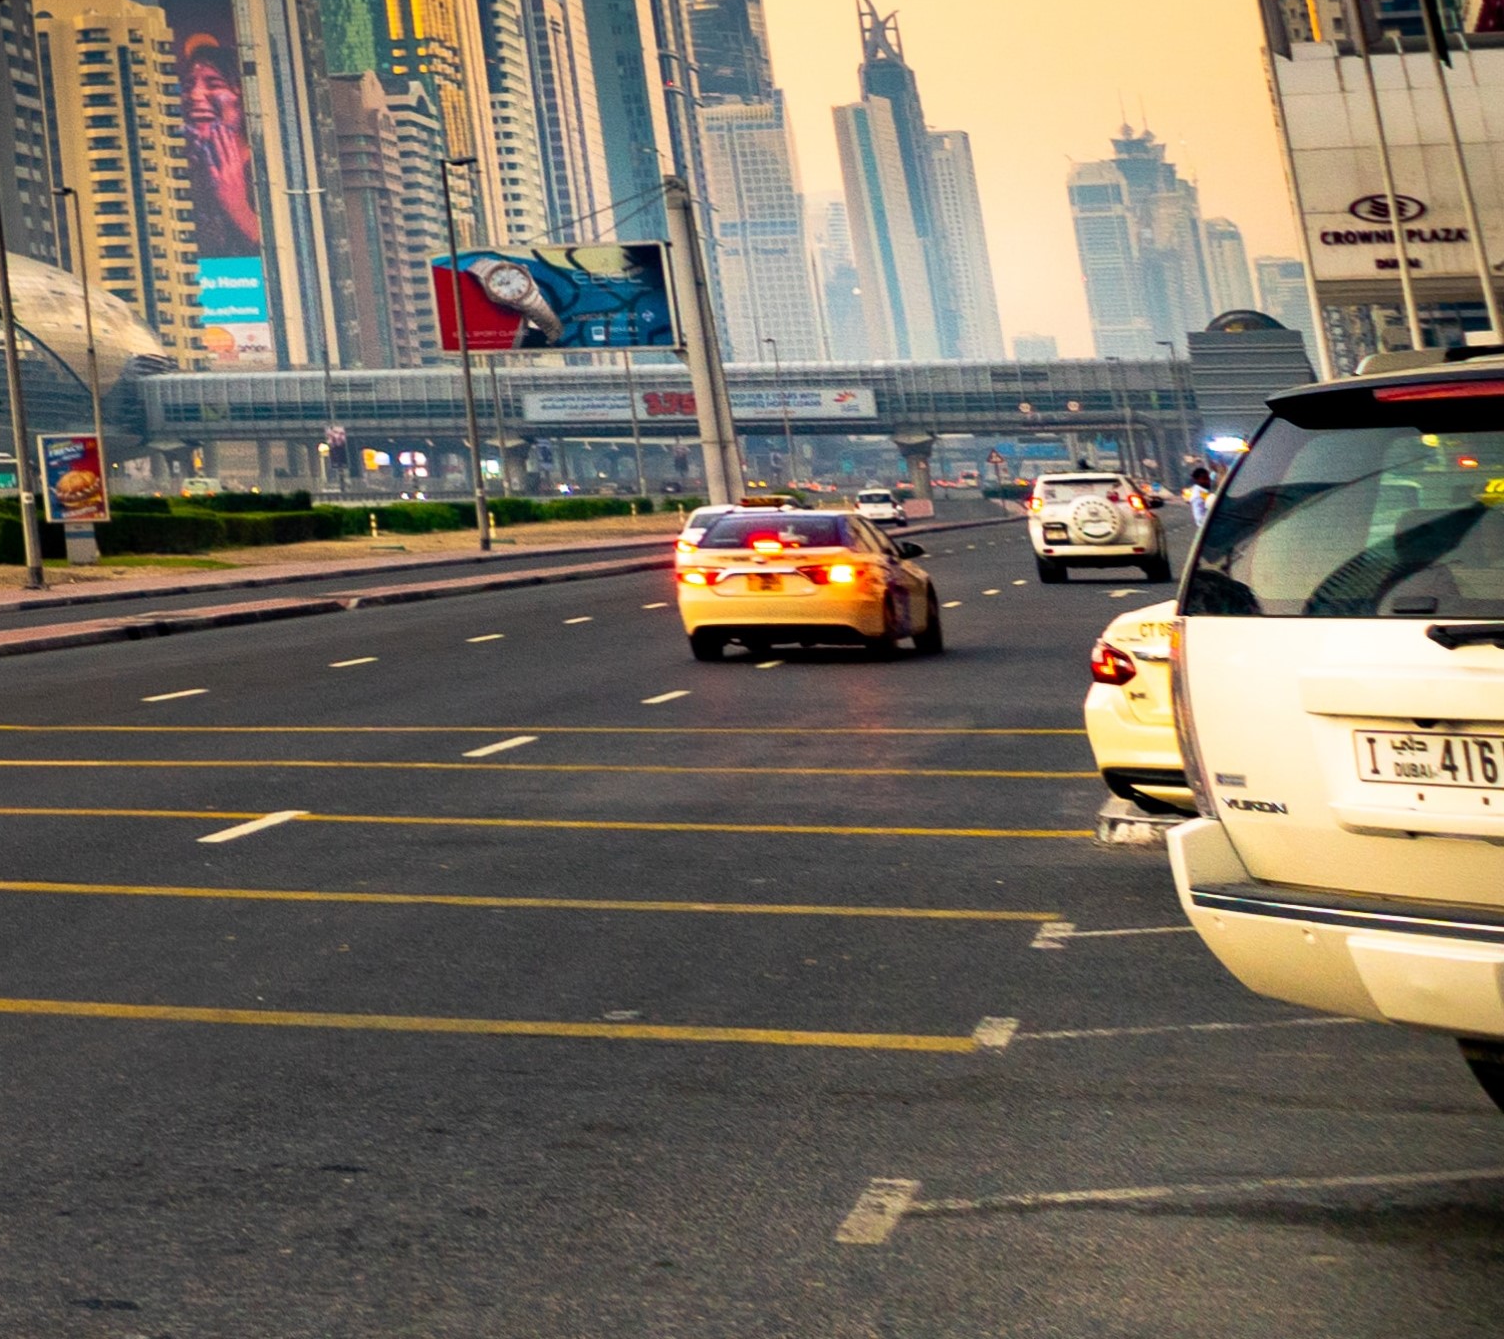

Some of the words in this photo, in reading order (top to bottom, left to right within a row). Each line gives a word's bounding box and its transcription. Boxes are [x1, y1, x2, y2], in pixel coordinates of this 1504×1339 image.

[1404, 227, 1468, 244] PLAZA
[1441, 738, 1504, 785] 416
[1394, 762, 1435, 779] DUBAI
[1221, 797, 1289, 815] YUKON
